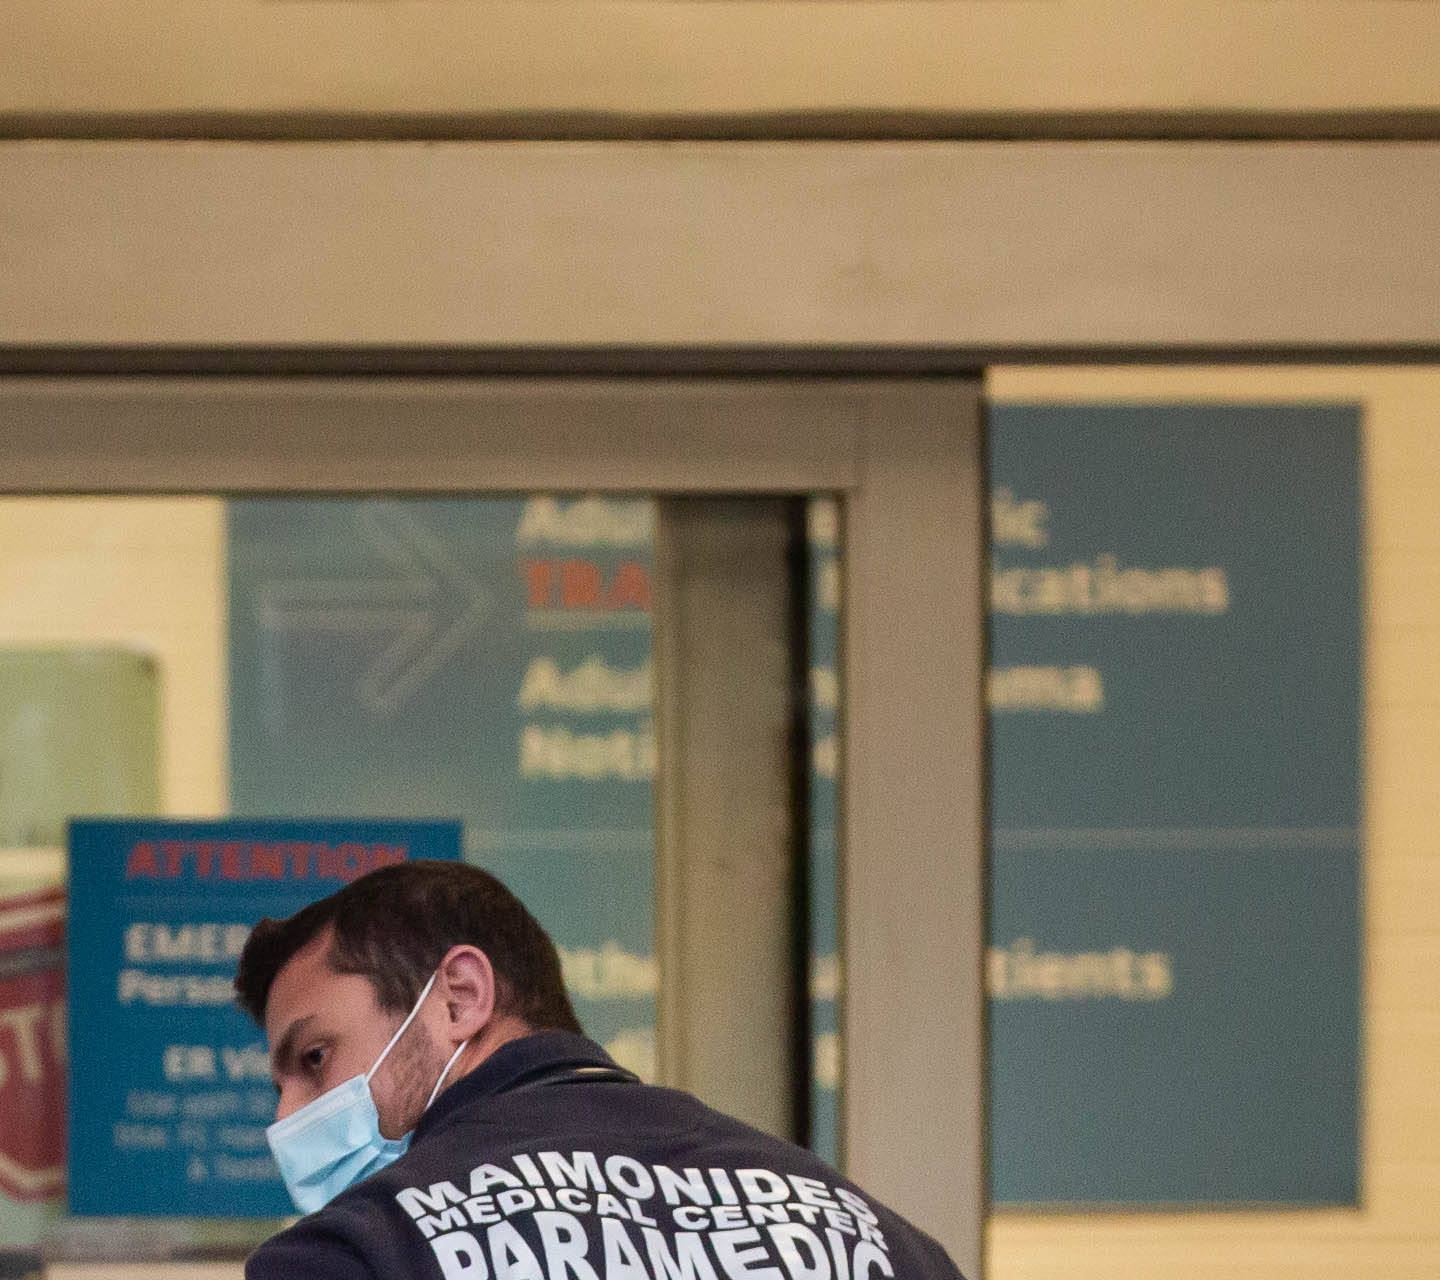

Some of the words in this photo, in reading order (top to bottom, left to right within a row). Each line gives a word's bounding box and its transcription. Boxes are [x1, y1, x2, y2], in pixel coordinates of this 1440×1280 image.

[126, 840, 408, 883] ATTENTION
[395, 1150, 879, 1228] MAIMONIDES
[415, 1186, 658, 1240] MEDICAL
[672, 1202, 889, 1252] CENTER
